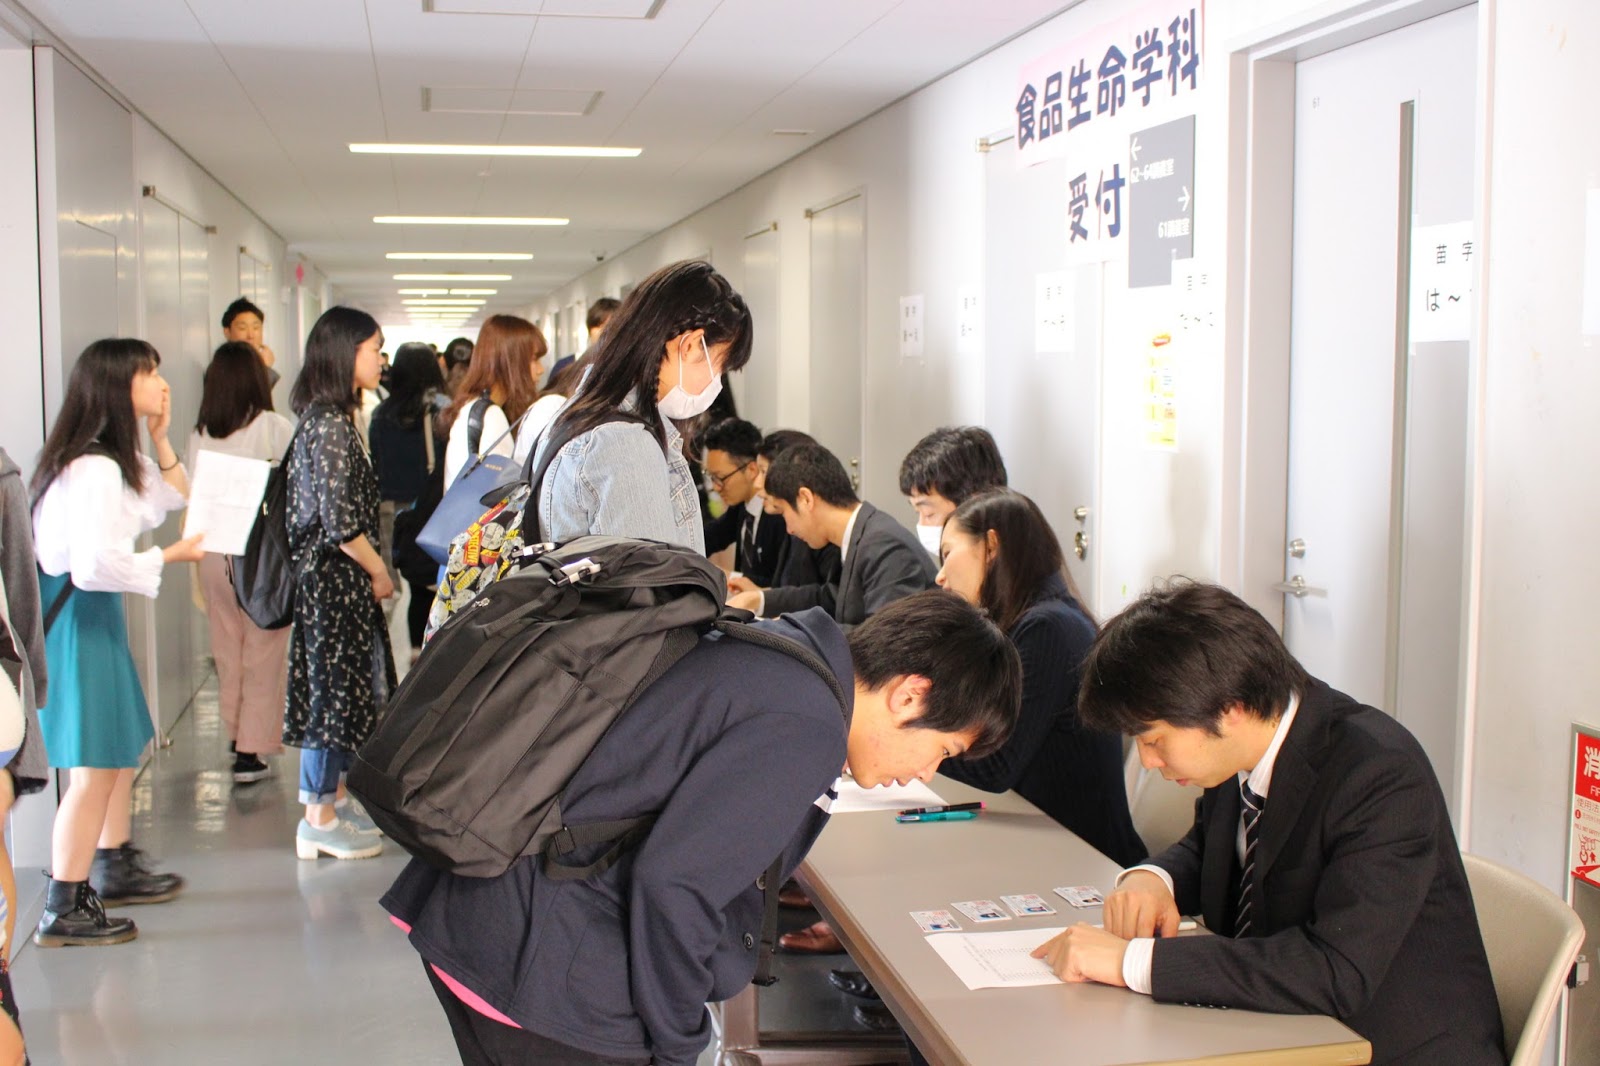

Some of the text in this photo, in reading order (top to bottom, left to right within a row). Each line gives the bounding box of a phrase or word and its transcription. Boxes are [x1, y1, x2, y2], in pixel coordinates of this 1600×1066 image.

[1016, 8, 1199, 150] 食品生命学科
[1068, 163, 1125, 243] 受付
